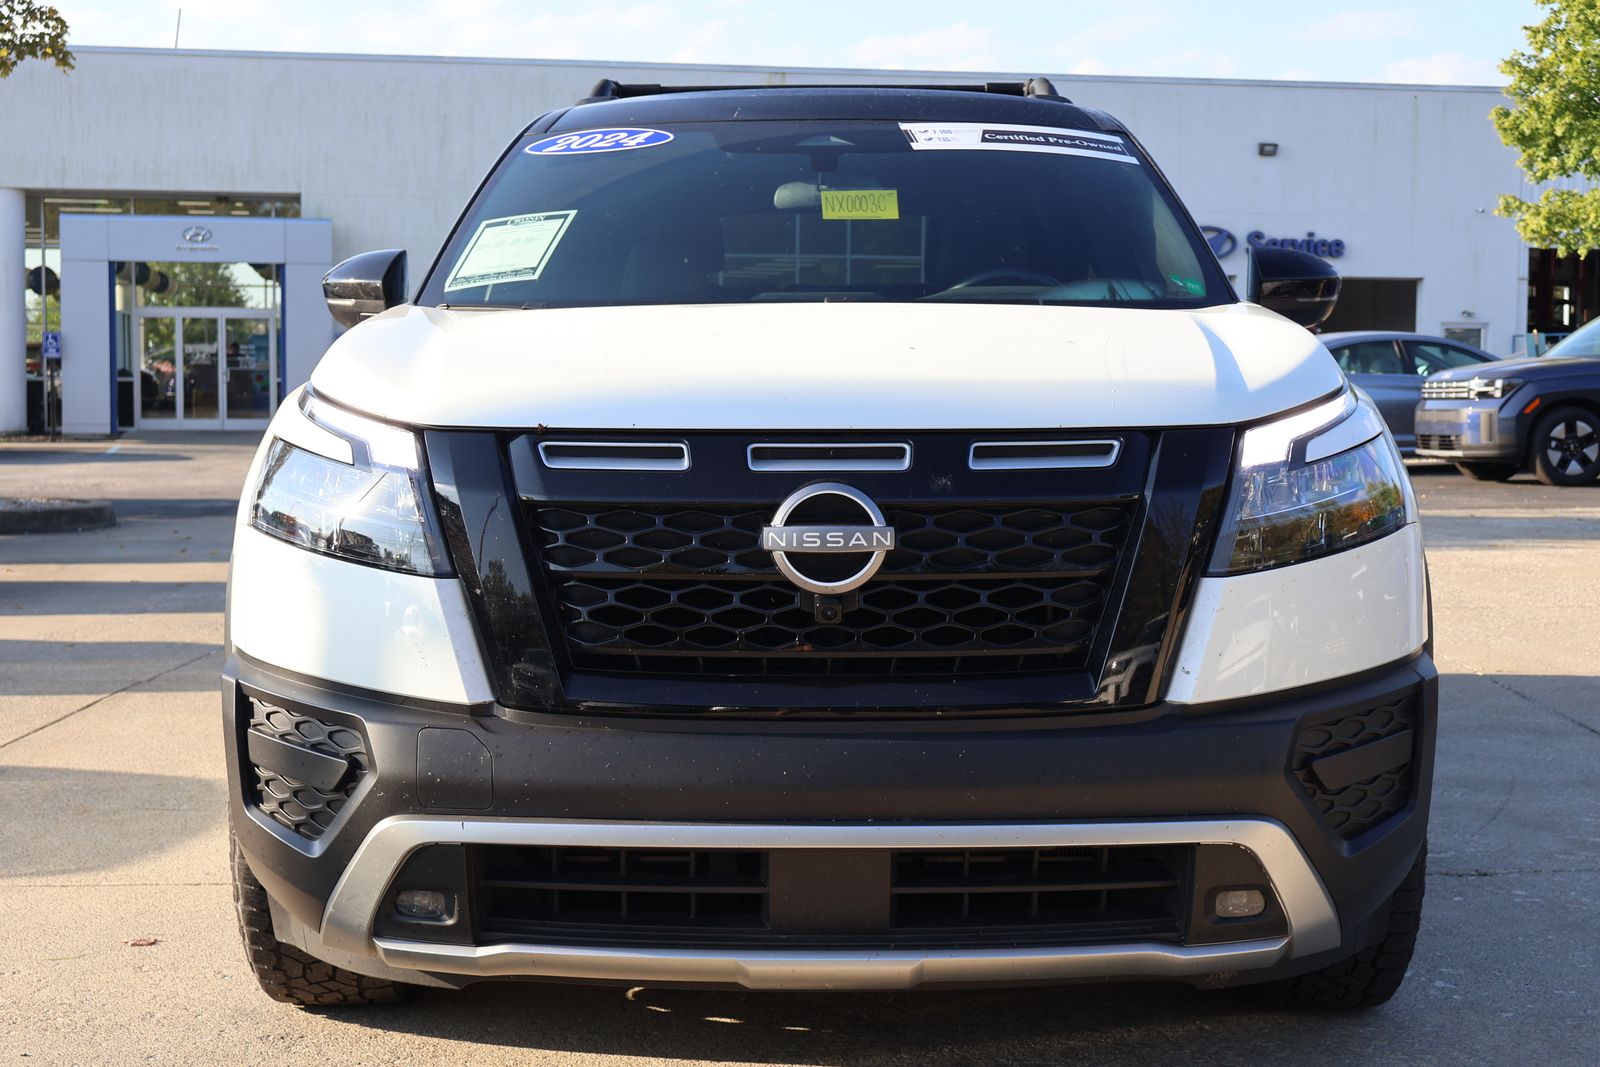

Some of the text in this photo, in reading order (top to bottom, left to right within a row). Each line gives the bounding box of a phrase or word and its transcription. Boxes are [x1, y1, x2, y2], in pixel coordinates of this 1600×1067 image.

[541, 131, 655, 153] 2024
[983, 132, 1123, 153] Certified Pre-Owned
[767, 531, 891, 547] NISSAN
